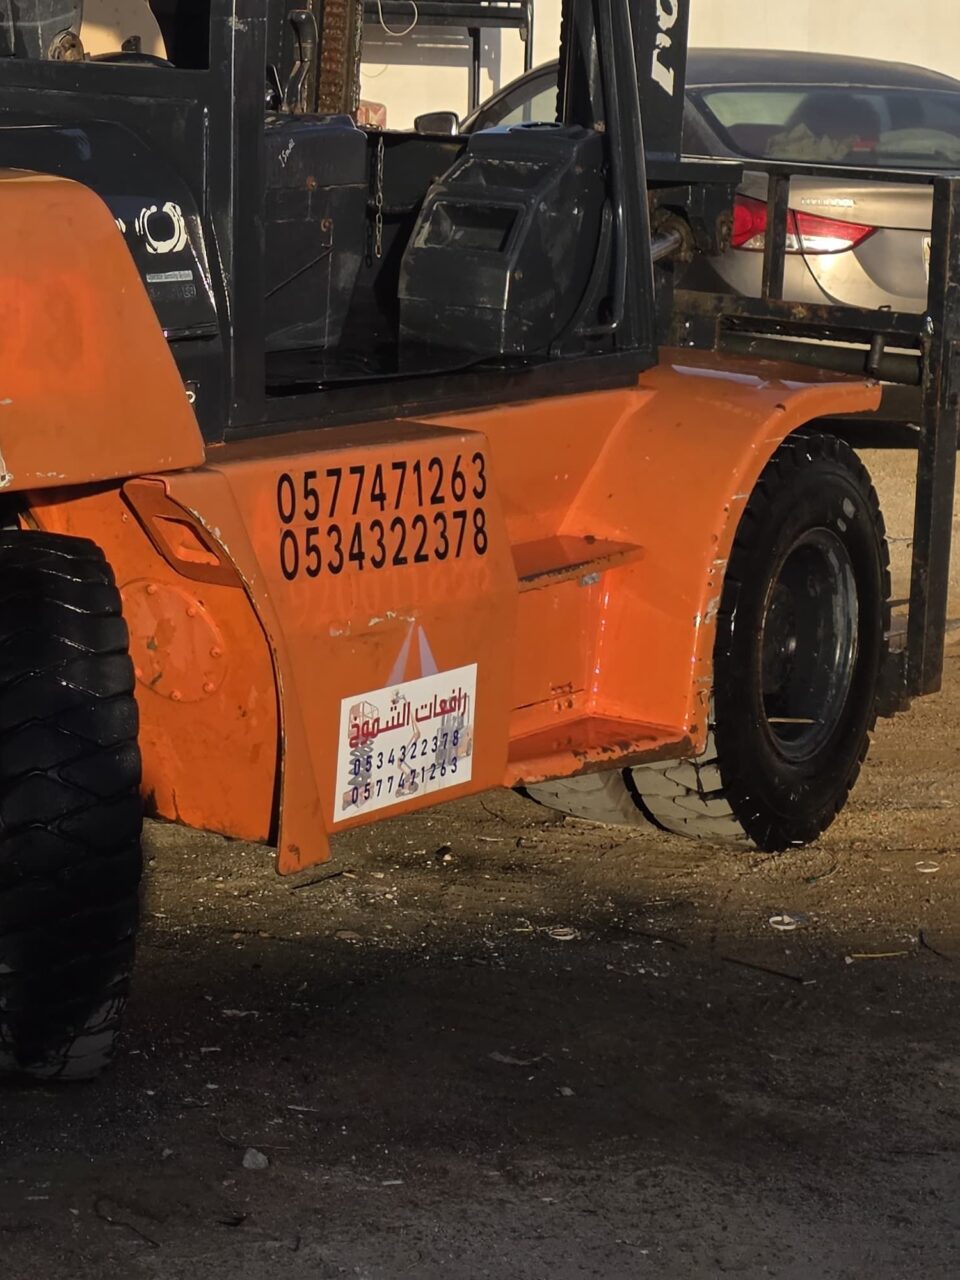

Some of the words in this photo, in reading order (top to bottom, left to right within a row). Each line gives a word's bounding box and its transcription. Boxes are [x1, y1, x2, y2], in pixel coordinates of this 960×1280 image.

[277, 452, 487, 524] 0577471263
[280, 507, 488, 581] 0534322378
[349, 701, 411, 749] الشموخ
[415, 687, 468, 723] رافعات
[353, 730, 460, 777] 0534322378
[351, 756, 459, 804] 0577471263
